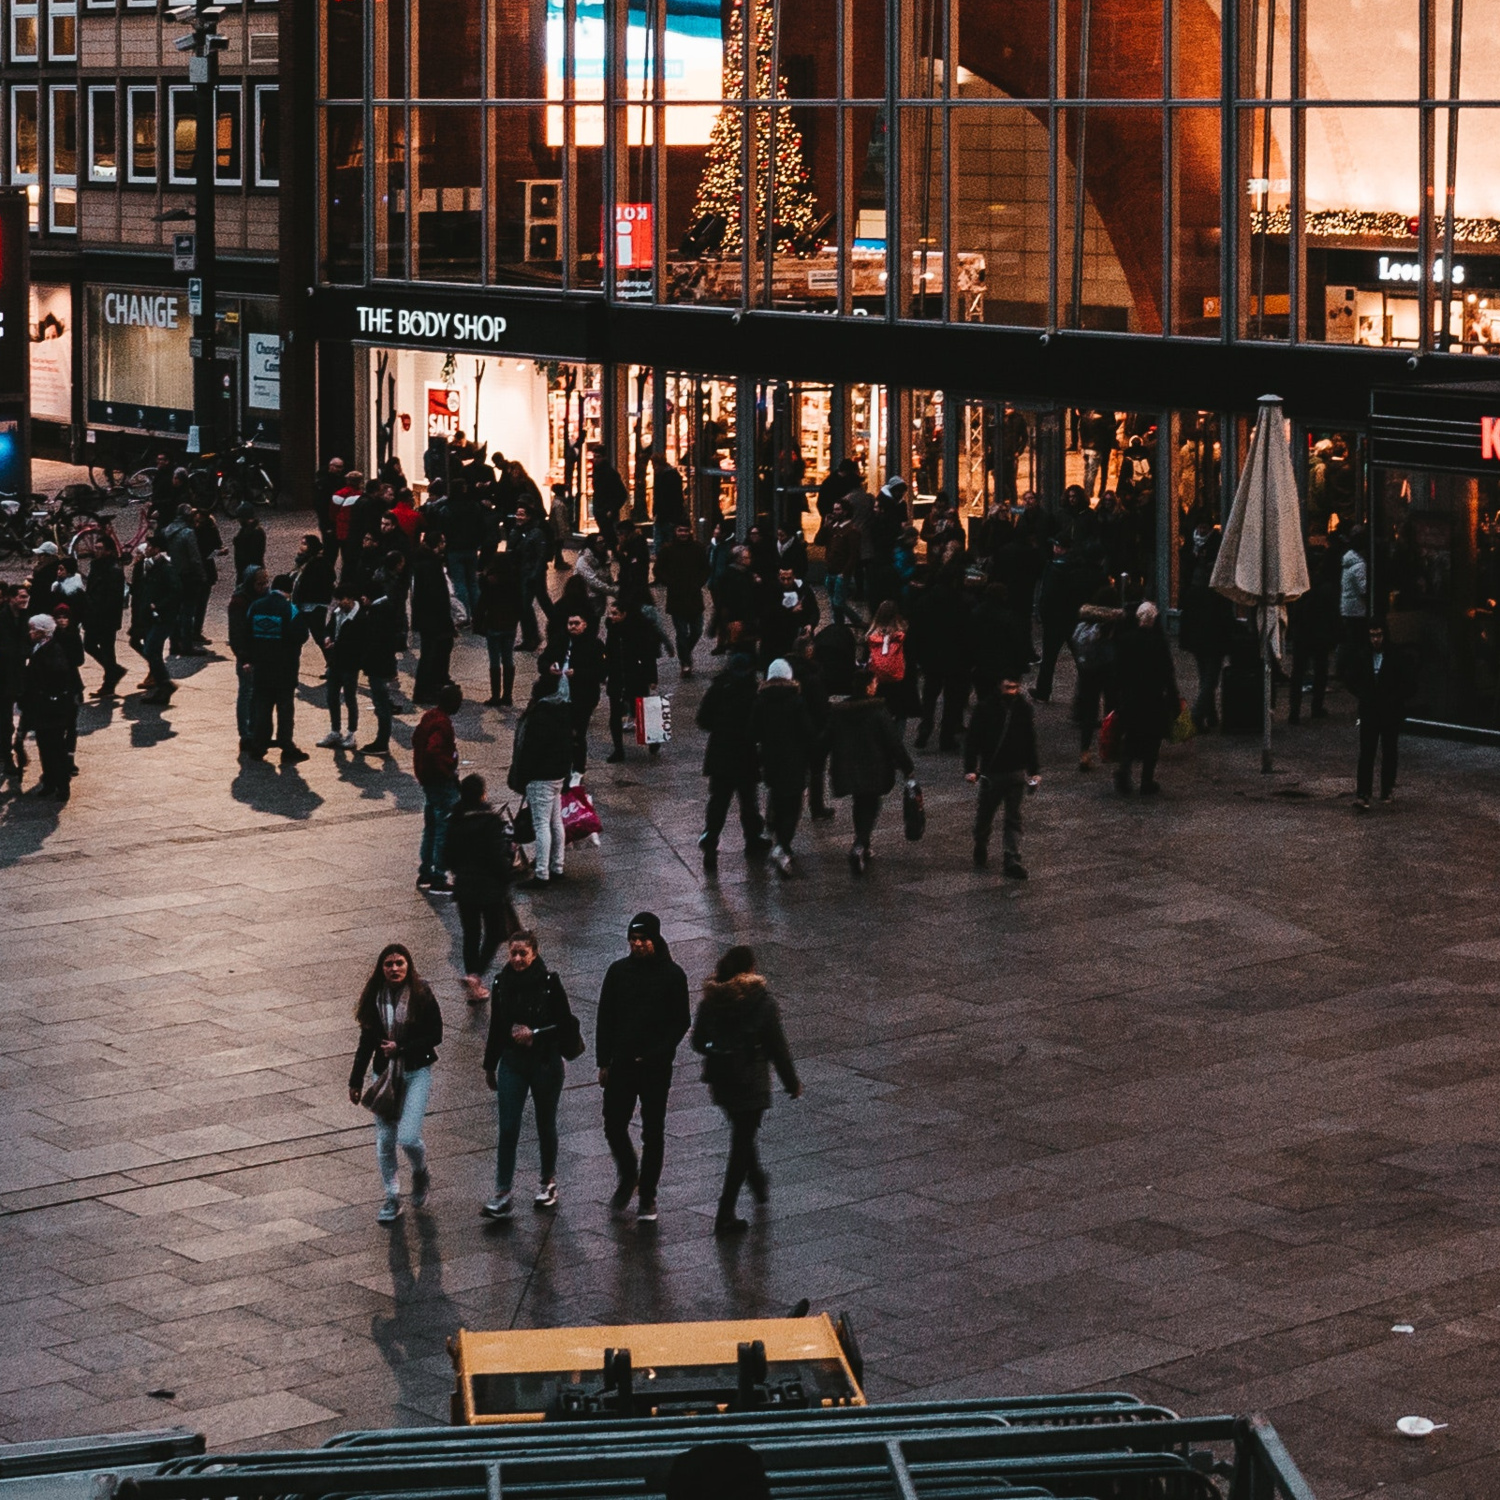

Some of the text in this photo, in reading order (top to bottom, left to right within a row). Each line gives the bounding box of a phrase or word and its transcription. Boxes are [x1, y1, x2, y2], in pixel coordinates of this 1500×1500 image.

[104, 292, 179, 329] CHANGE
[356, 306, 507, 342] THE BODY SHOP
[256, 341, 280, 360] Chang
[428, 413, 459, 436] SALE
